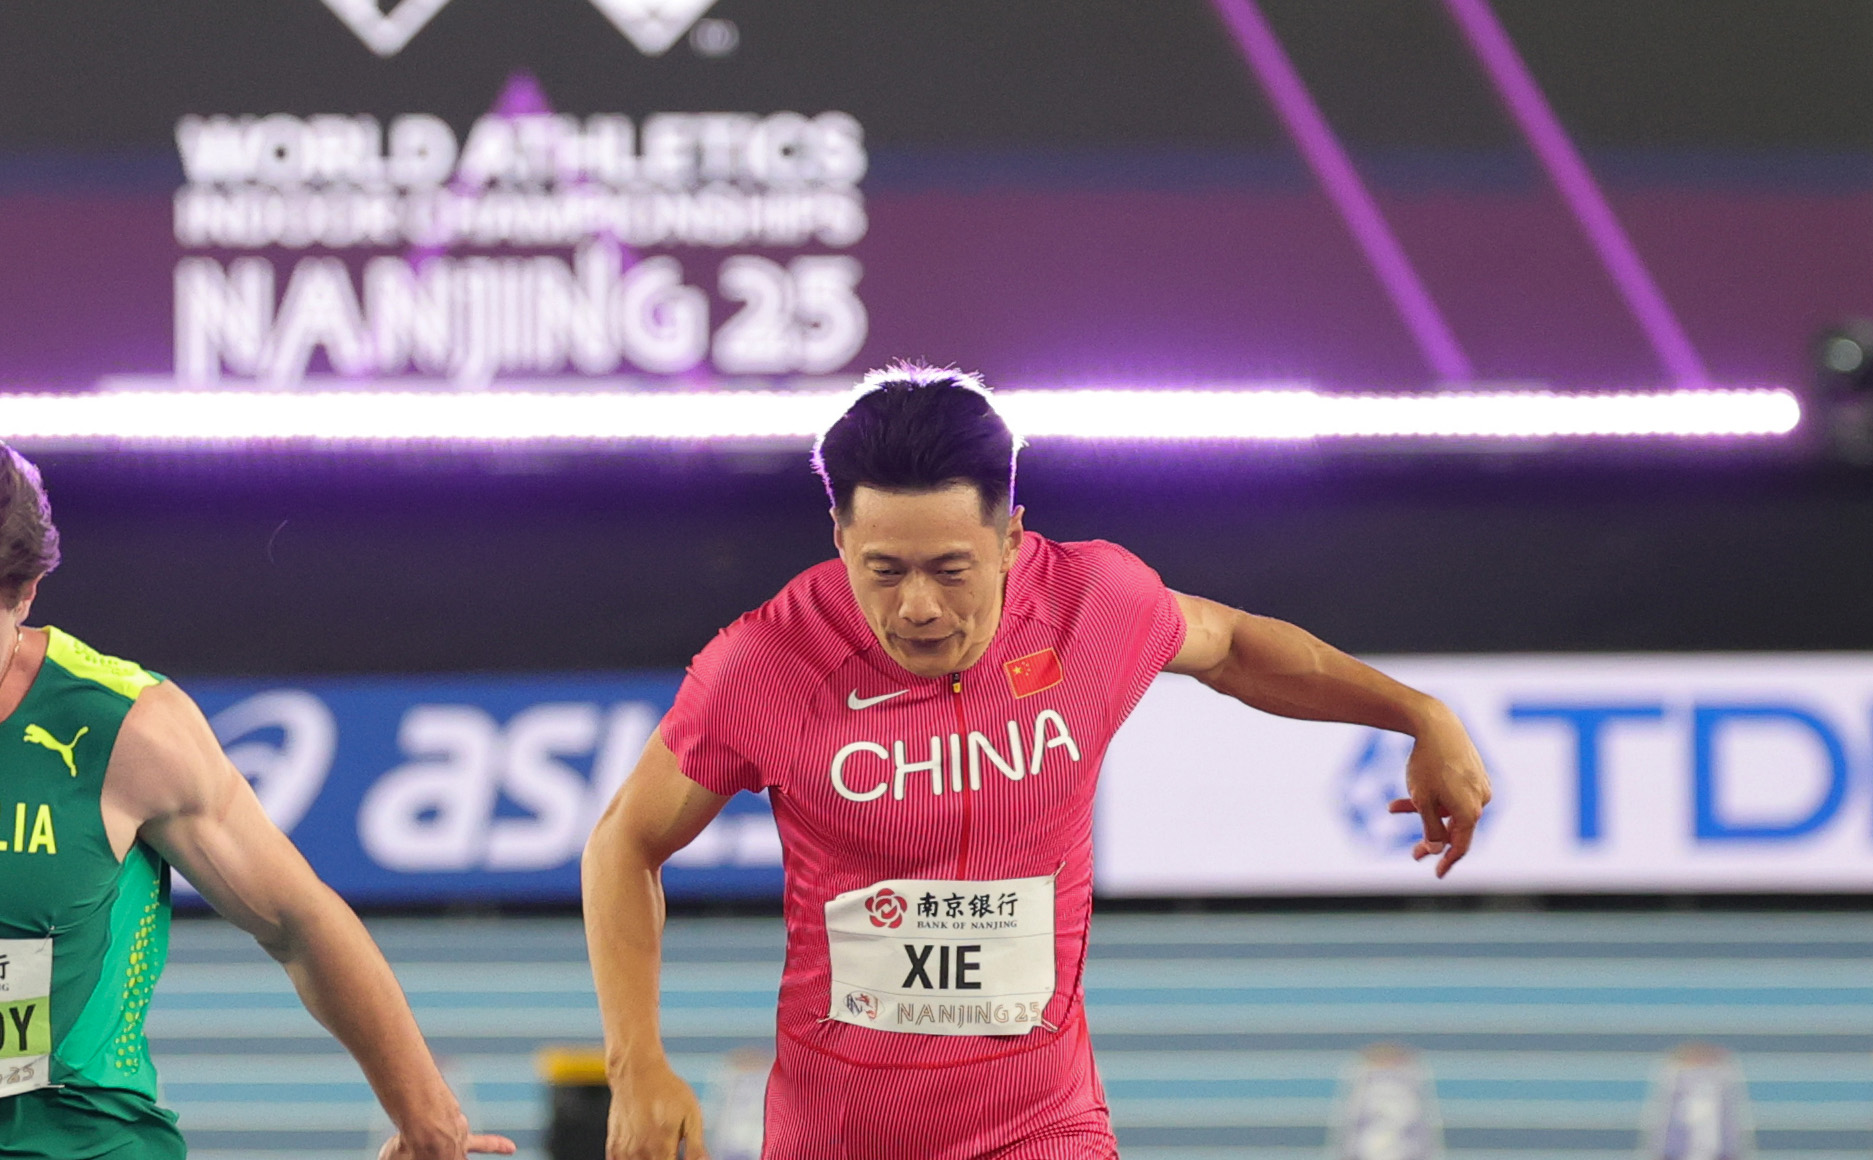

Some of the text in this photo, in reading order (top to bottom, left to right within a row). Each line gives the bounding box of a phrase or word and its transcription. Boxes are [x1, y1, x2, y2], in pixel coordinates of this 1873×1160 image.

[175, 112, 868, 188] WORLD ATHLETICS
[174, 252, 868, 388] NANJING 25
[830, 709, 1081, 803] CHINA
[1503, 700, 1873, 846] TD
[916, 891, 1019, 919] 南京银行
[917, 920, 1018, 930] BANK OF NANJING
[901, 944, 982, 990] XIE
[896, 1001, 1042, 1028] NANJING 25
